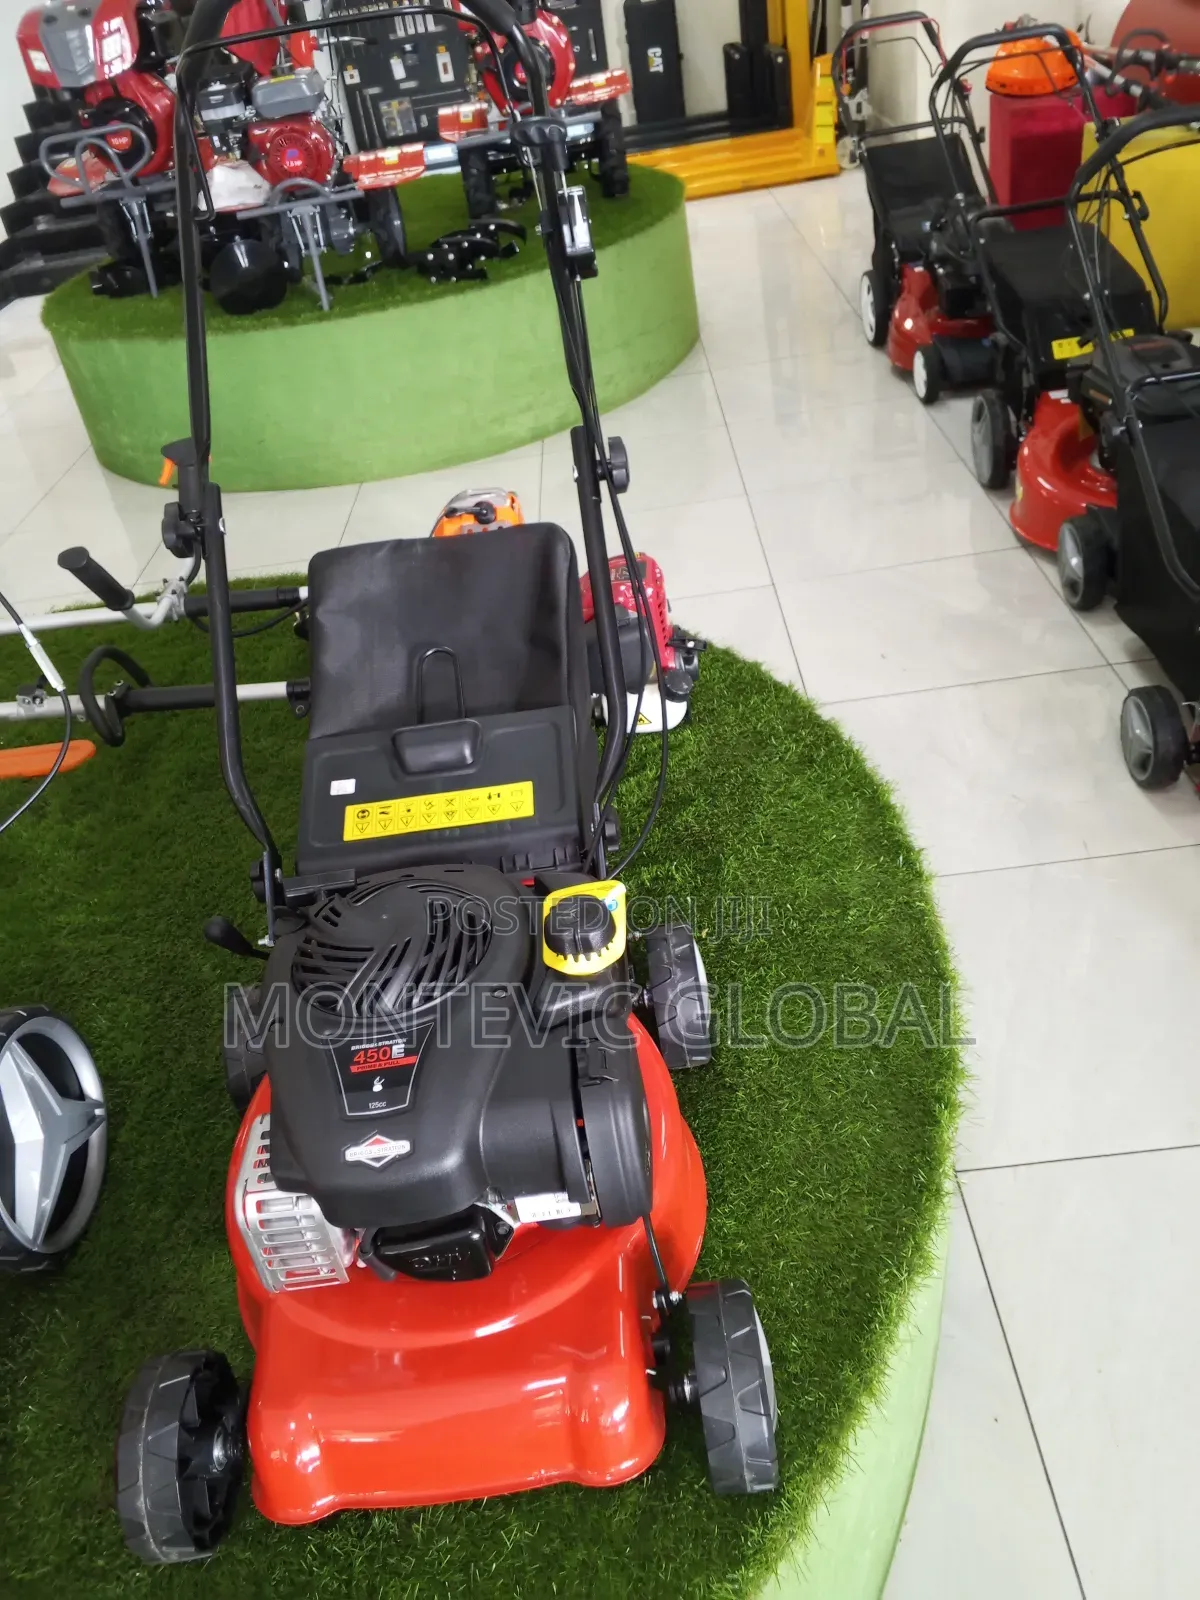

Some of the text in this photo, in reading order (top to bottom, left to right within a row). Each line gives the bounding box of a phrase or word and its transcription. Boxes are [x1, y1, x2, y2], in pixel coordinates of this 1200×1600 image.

[647, 46, 664, 73] CAT
[353, 1044, 405, 1063] 450E
[356, 1063, 378, 1071] PRIME
[384, 1059, 401, 1067] PULL
[368, 1101, 387, 1109] 125cc
